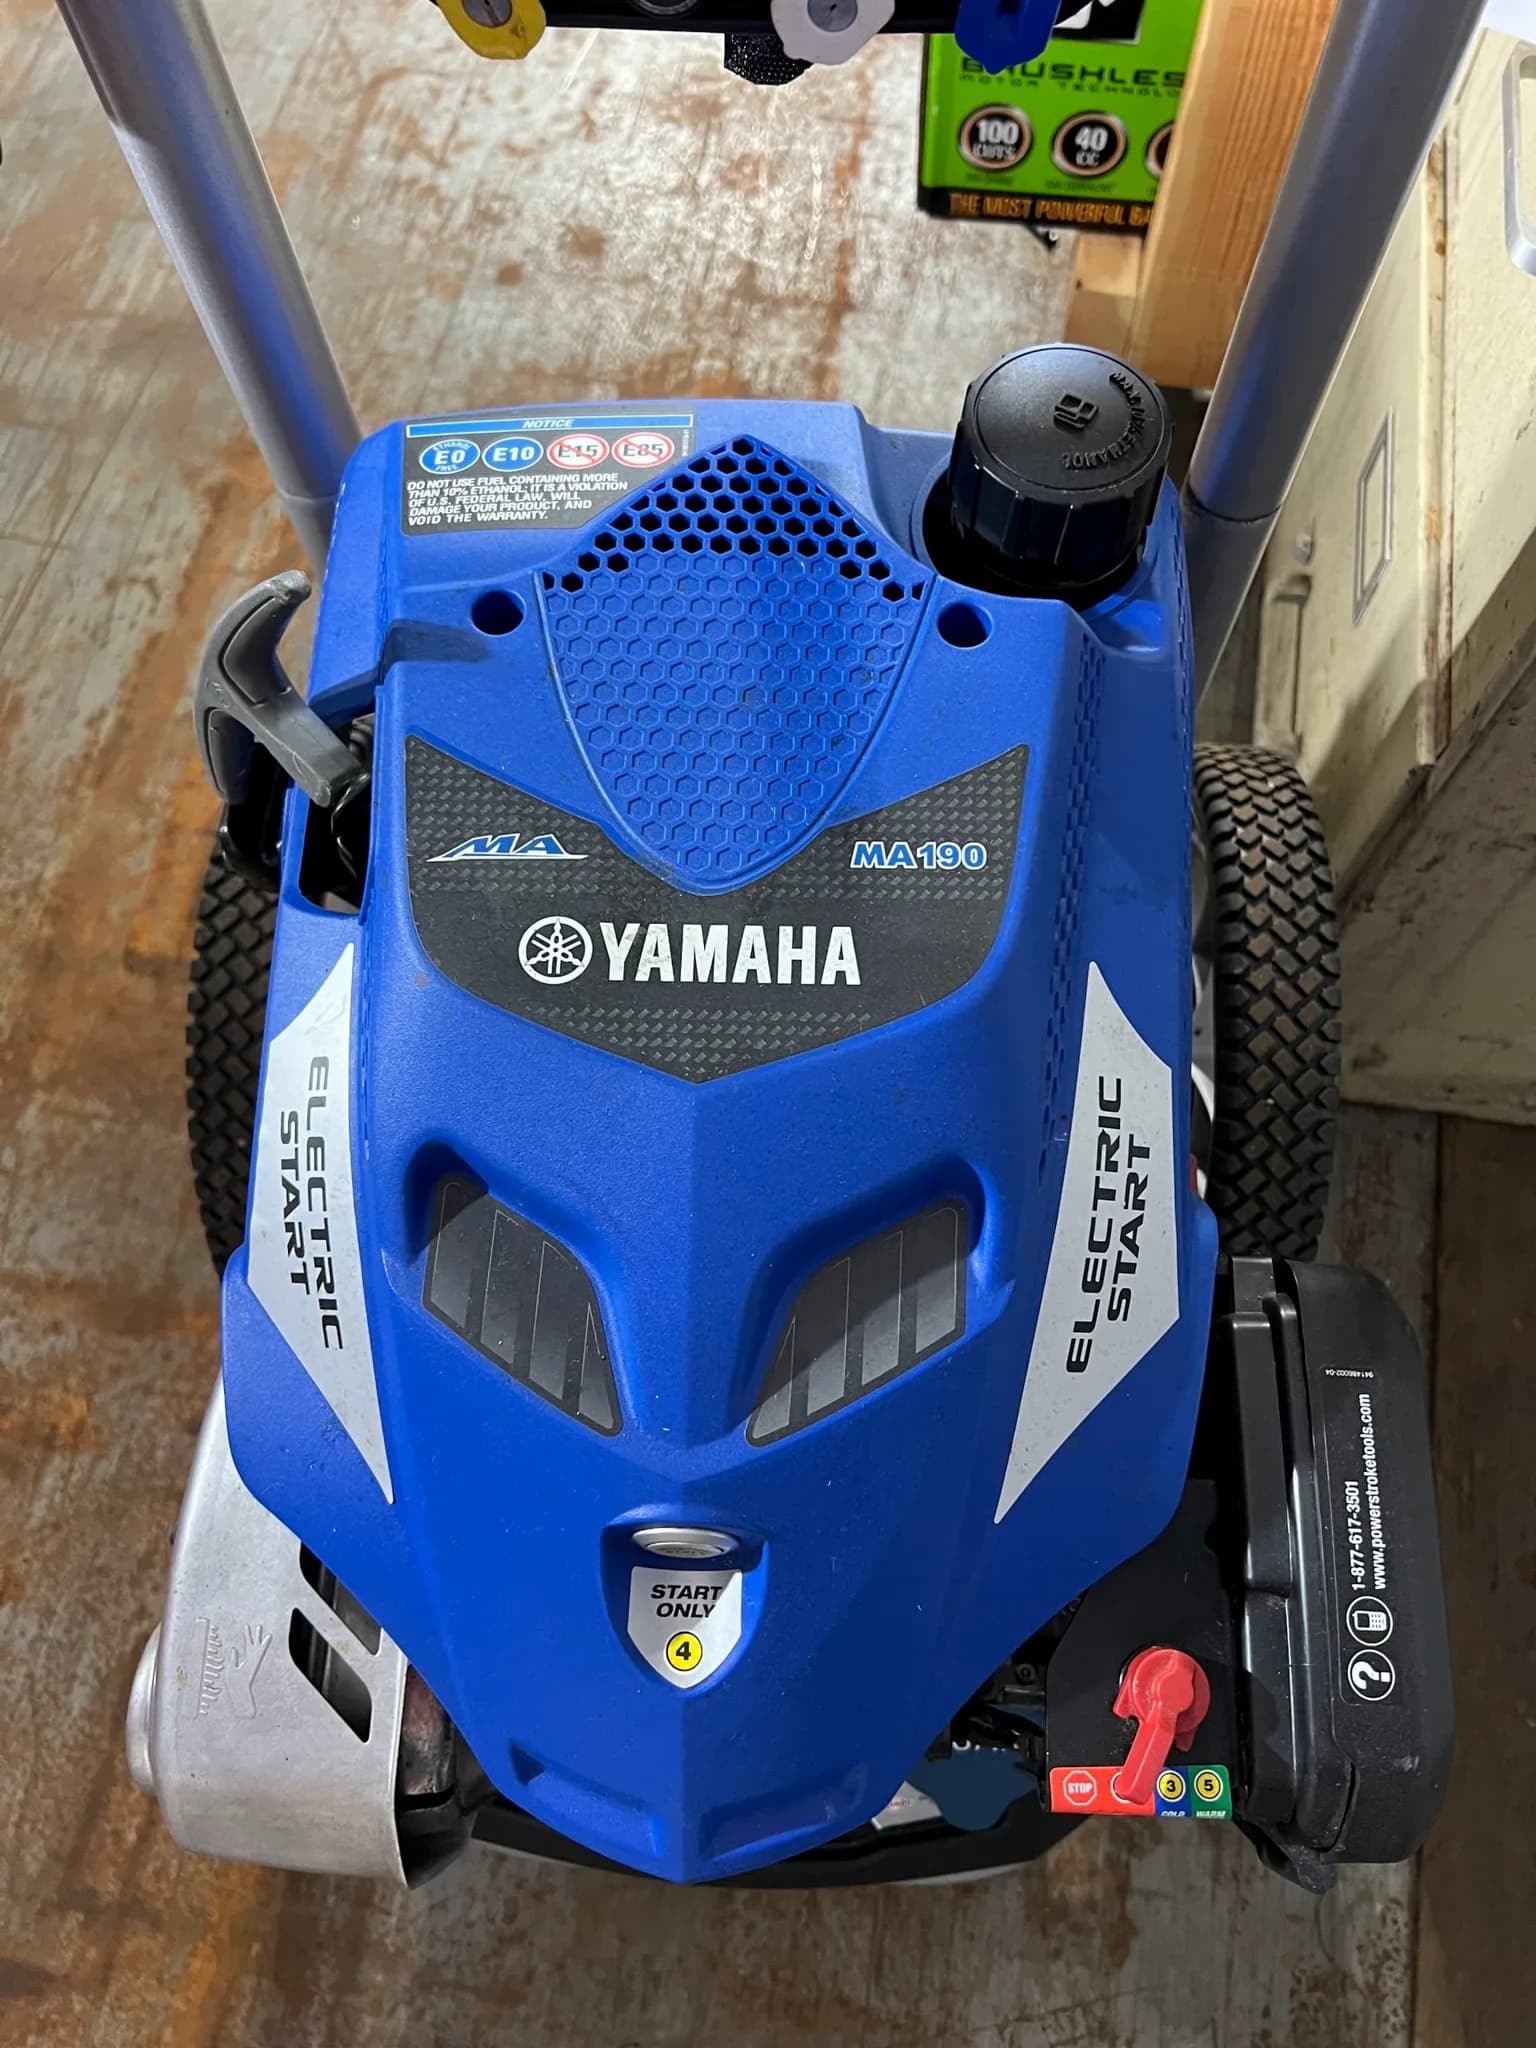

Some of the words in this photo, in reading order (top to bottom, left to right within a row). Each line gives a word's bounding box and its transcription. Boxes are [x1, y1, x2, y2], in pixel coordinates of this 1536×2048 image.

[977, 120, 1019, 144] 100
[1075, 126, 1108, 151] 40
[522, 419, 575, 429] NOTICE
[434, 449, 466, 465] E0
[493, 446, 535, 462] E10
[558, 444, 598, 458] E15
[623, 443, 664, 457] E85
[407, 481, 424, 491] DO
[427, 480, 451, 490] NOT
[452, 478, 475, 488] USE
[477, 477, 507, 487] FUEL
[509, 474, 580, 485] CONTAINING
[583, 473, 619, 483] MORE
[408, 488, 441, 499] THAN
[443, 487, 468, 497] 10%
[530, 484, 542, 493] IT
[544, 484, 556, 493] IS
[557, 483, 567, 492] A
[568, 481, 628, 491] VIOLATION
[409, 498, 425, 508] OF
[427, 497, 451, 507] U.S.
[456, 494, 511, 505] FEDERAL
[551, 491, 581, 501] WILL
[409, 506, 461, 517] DAMAGE
[463, 504, 498, 514] YOUR
[564, 500, 592, 510] AND
[408, 515, 441, 526] VOID
[446, 514, 472, 524] THE
[477, 511, 549, 523] WARRANTY.
[430, 833, 584, 862] MA
[850, 841, 986, 870] MA190
[600, 923, 861, 985] YAMAHA
[280, 1109, 310, 1295] START
[306, 1055, 344, 1350] ELECTRIC
[1066, 1075, 1122, 1373] ELECTRIC
[1107, 1134, 1150, 1322] START
[1358, 1393, 1387, 1590] www.powerstroketools.com
[1344, 1480, 1366, 1591] 1-877-617-3501
[651, 1584, 722, 1600] START
[656, 1603, 716, 1618] ONLY
[676, 1641, 691, 1661] 4
[1068, 1782, 1092, 1793] STOP
[1166, 1780, 1176, 1792] 3
[1204, 1779, 1213, 1791] 5
